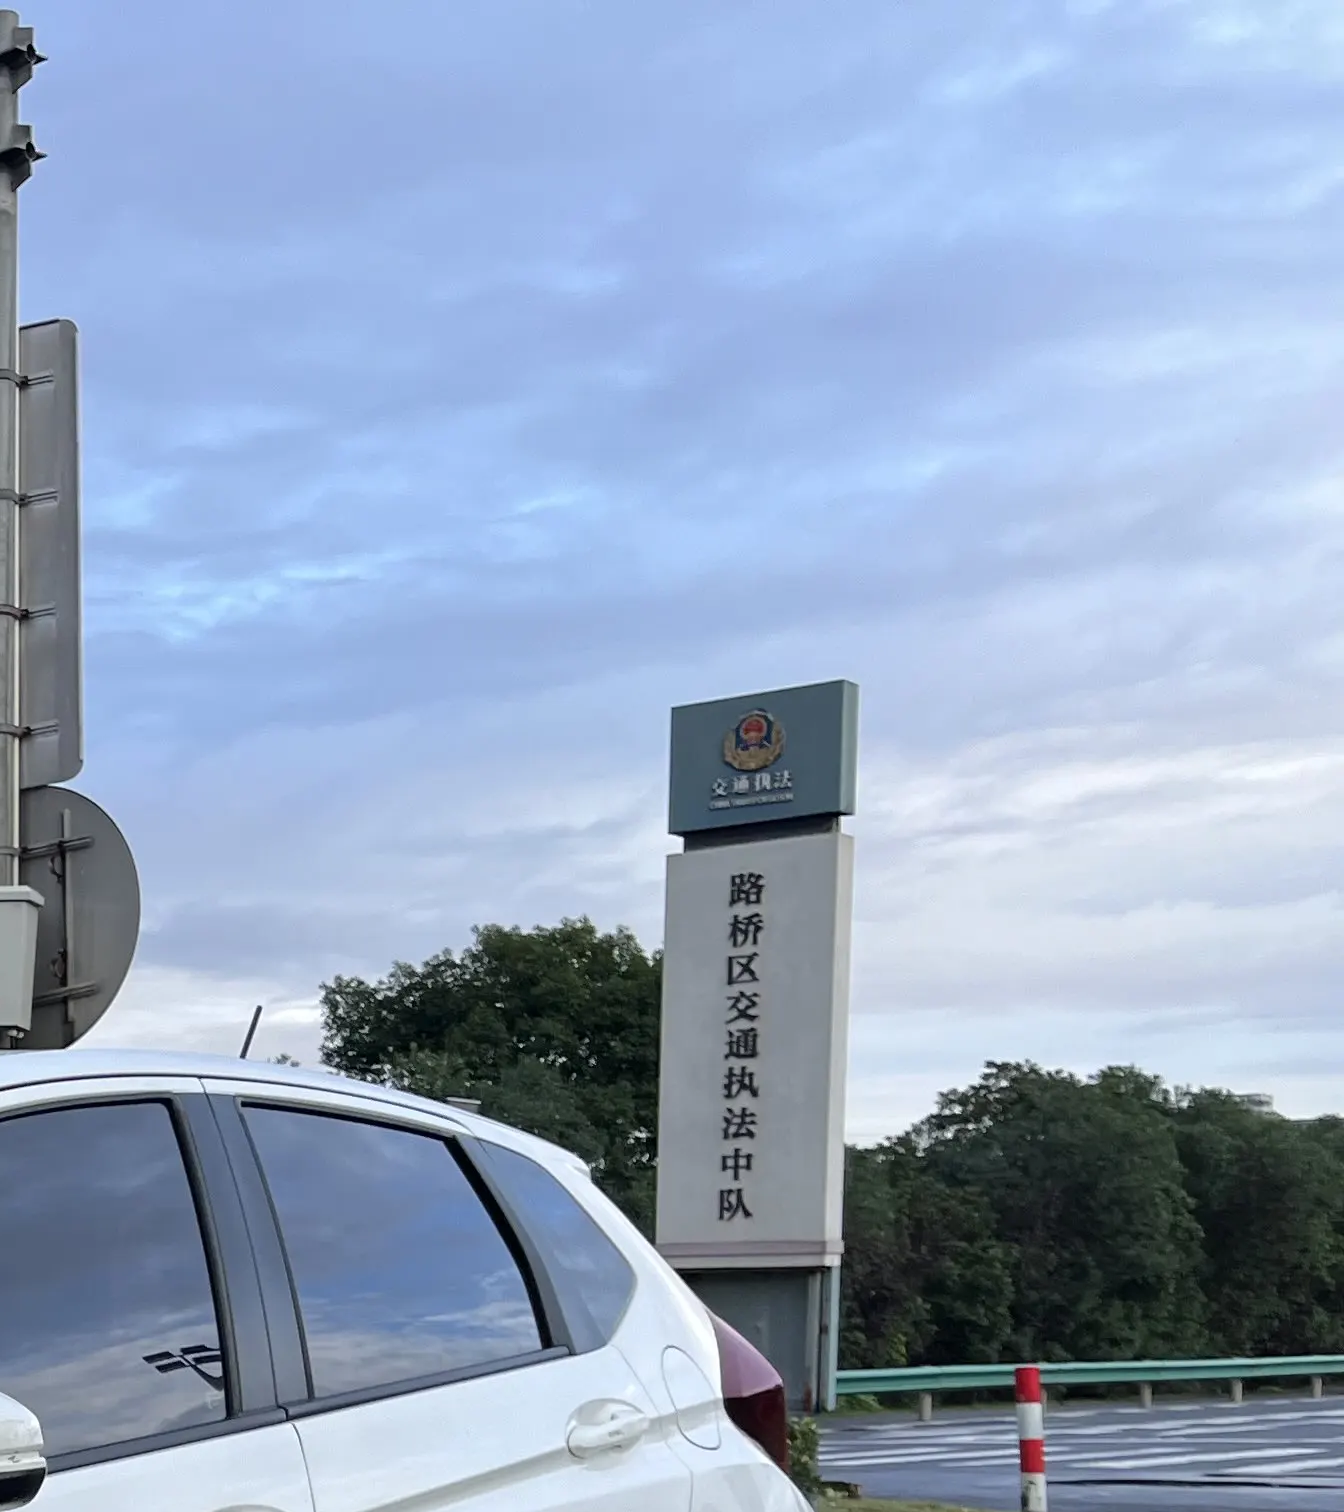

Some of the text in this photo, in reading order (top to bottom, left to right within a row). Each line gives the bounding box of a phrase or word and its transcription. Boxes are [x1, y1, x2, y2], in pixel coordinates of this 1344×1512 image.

[717, 871, 766, 1223] 路桥区交通执法中队
